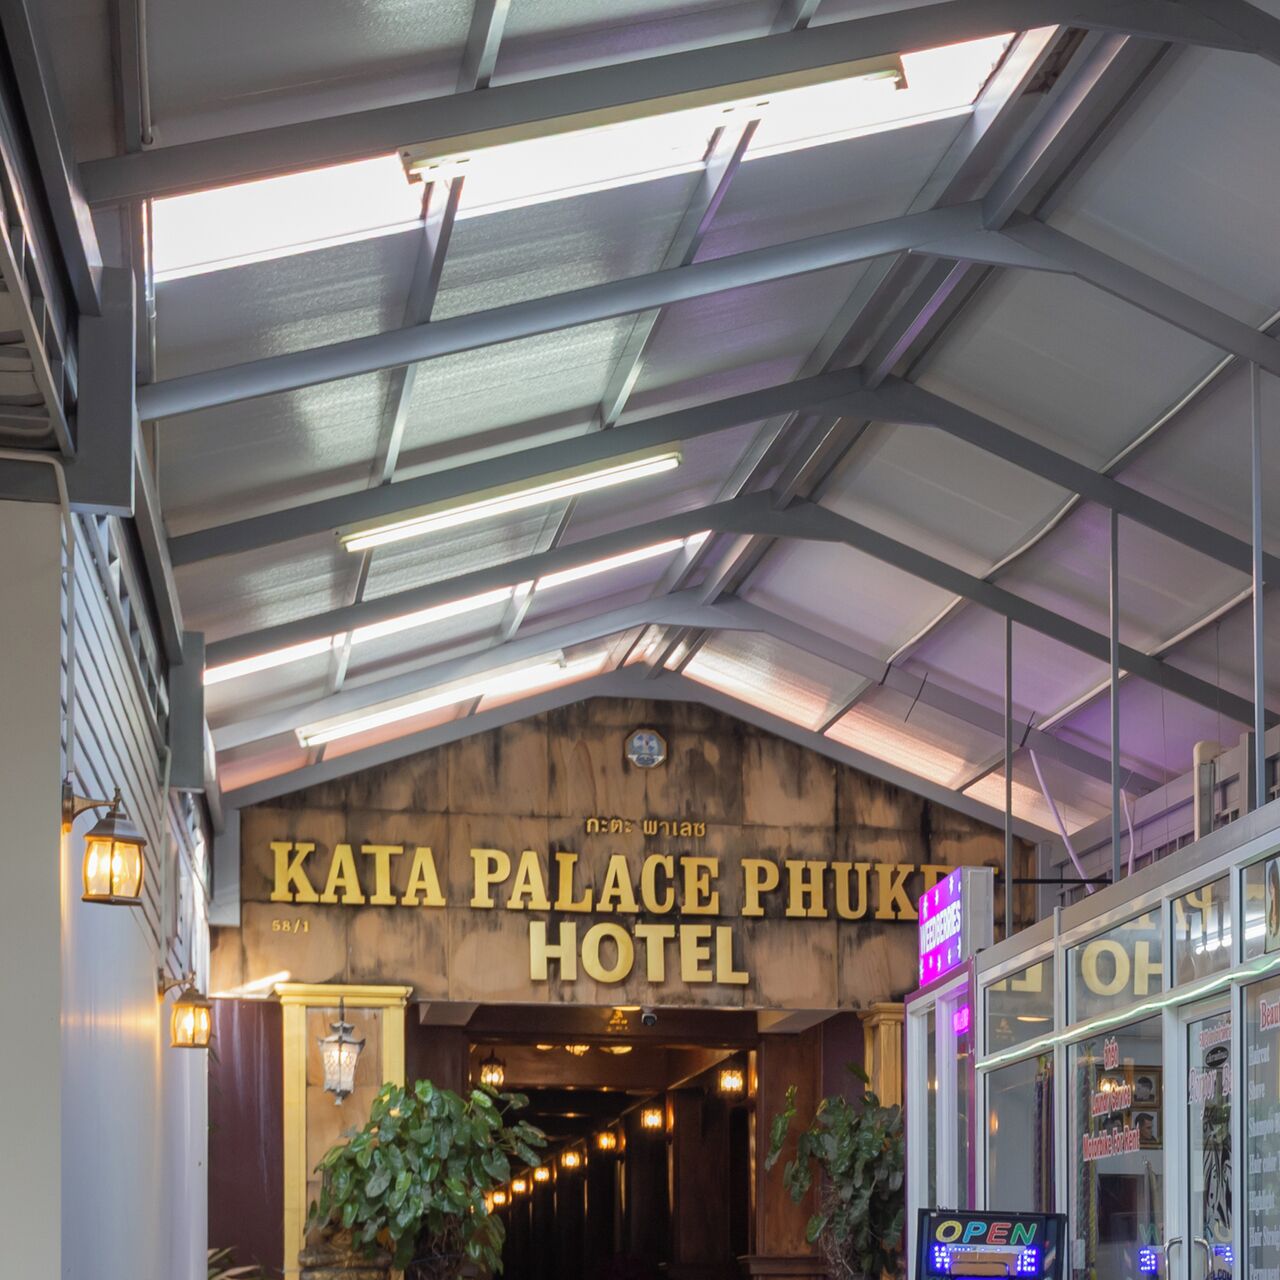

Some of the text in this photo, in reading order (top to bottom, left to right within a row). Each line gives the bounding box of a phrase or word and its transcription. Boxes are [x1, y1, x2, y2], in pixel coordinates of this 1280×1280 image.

[270, 841, 998, 921] KATA PALACE PHUK
[271, 919, 310, 934] 58/1
[529, 921, 749, 984] HOTEL
[935, 1220, 1037, 1245] OPEN
